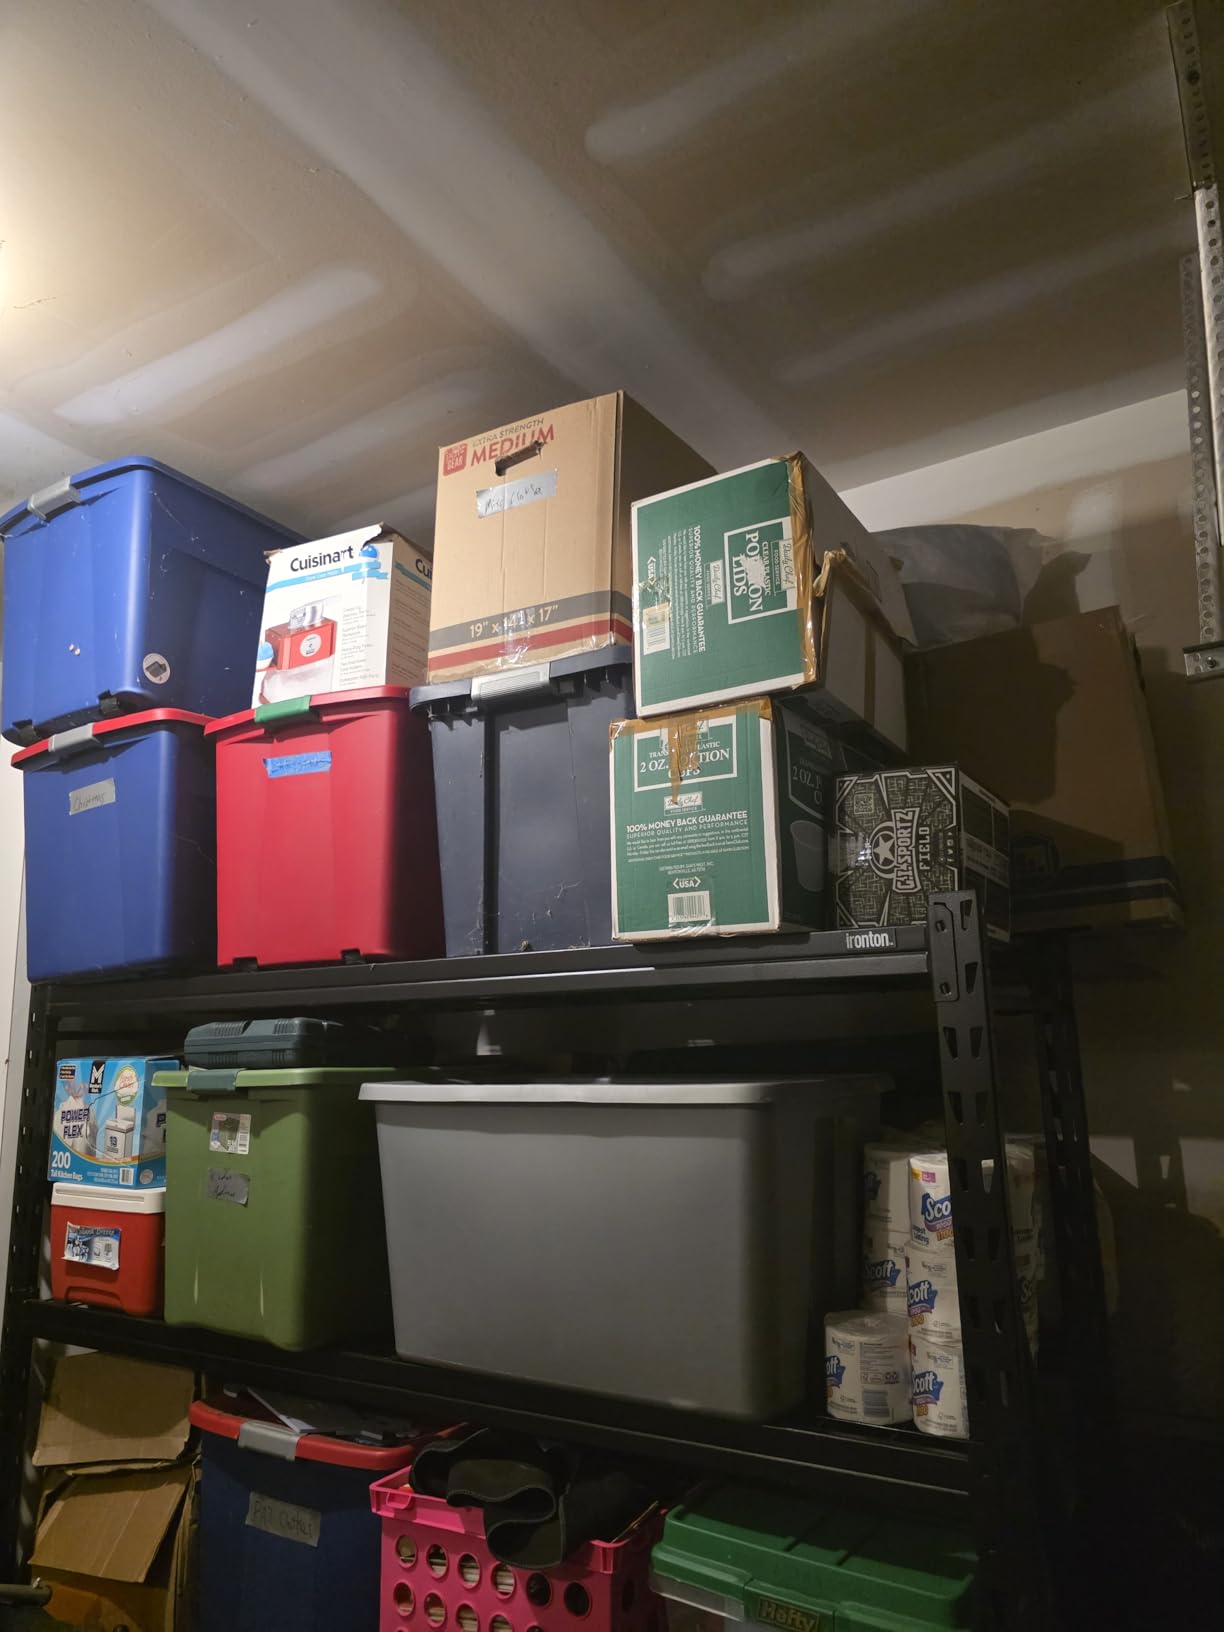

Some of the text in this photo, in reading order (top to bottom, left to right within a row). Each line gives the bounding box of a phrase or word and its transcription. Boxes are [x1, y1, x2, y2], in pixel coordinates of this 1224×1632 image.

[472, 418, 545, 447] EXTRA STRENGTH
[471, 424, 555, 467] MEDIUM
[290, 546, 355, 572] Cuisinart
[694, 549, 703, 578] MONEY
[762, 541, 770, 564] CLEAR
[733, 554, 748, 597] LIDS
[746, 530, 763, 612] POON
[696, 579, 704, 602] BACK
[470, 621, 489, 638] 19"
[491, 624, 500, 634] x
[527, 614, 536, 625] x
[539, 604, 559, 622] 17"
[697, 602, 706, 653] GUARANTEE
[639, 762, 647, 773] 2
[648, 758, 669, 772] OZ.
[626, 810, 748, 833] 100% MONEY BACK GUARANTEE
[626, 819, 748, 840] SUPERIOR QUALITY AND PERFORMANCE
[895, 810, 913, 865] SPORTZ
[919, 826, 931, 870] FIELD
[679, 879, 695, 888] USA
[846, 931, 889, 949] ironton
[61, 1108, 90, 1124] POWER
[63, 1124, 84, 1139] FLEX
[51, 1151, 71, 1169] 200
